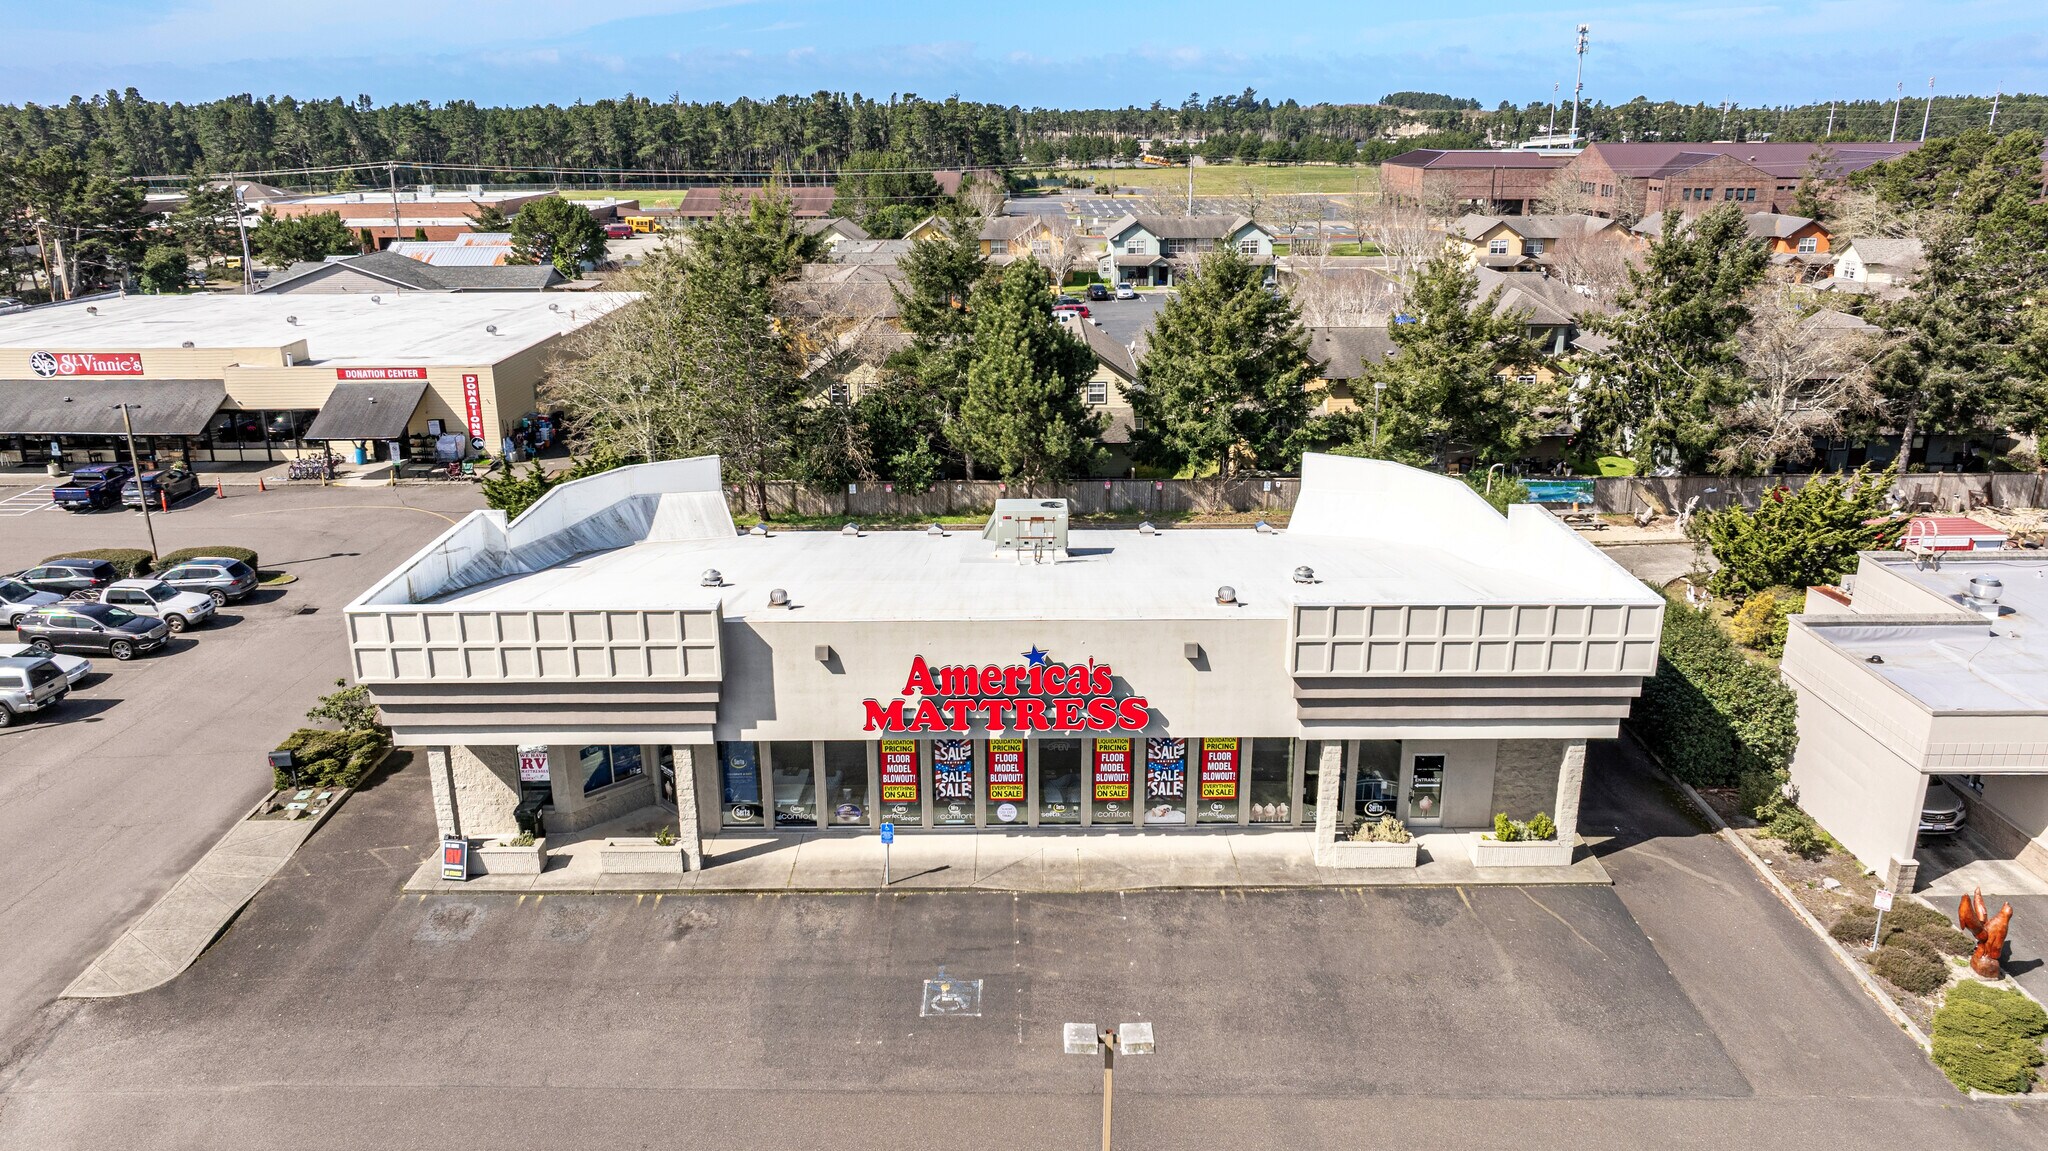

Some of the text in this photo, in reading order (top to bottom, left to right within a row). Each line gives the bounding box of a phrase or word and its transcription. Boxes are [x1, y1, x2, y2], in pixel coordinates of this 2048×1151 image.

[78, 354, 142, 372] Vinnie's
[345, 369, 418, 378] DONATION CENTER
[466, 376, 482, 436] DONATIONS
[902, 654, 1113, 696] America's
[862, 697, 1150, 732] MATTRESS
[940, 747, 967, 760] SALE
[1102, 753, 1124, 762] FLOOR
[1154, 746, 1180, 760] SALE
[1209, 752, 1232, 760] FLOOR
[888, 754, 910, 763] FLOOR
[995, 754, 1018, 762] FLOOR
[521, 758, 546, 769] RV
[887, 764, 911, 772] MODEL
[994, 764, 1019, 772] MODEL
[1100, 764, 1125, 772] MODEL
[1208, 762, 1232, 770] MODEL
[883, 774, 916, 782] BLOWOUT!
[942, 771, 967, 782] SALE
[990, 774, 1023, 782] BLOWOUT!
[1096, 773, 1128, 782] BLOWOUT!
[1154, 770, 1180, 782] SALE
[1203, 772, 1236, 780] BLOWOUT!
[940, 783, 970, 796] SALE
[1152, 782, 1181, 796] SALE
[736, 808, 750, 816] Serta
[1368, 804, 1383, 812] Serta
[446, 848, 462, 864] RV
